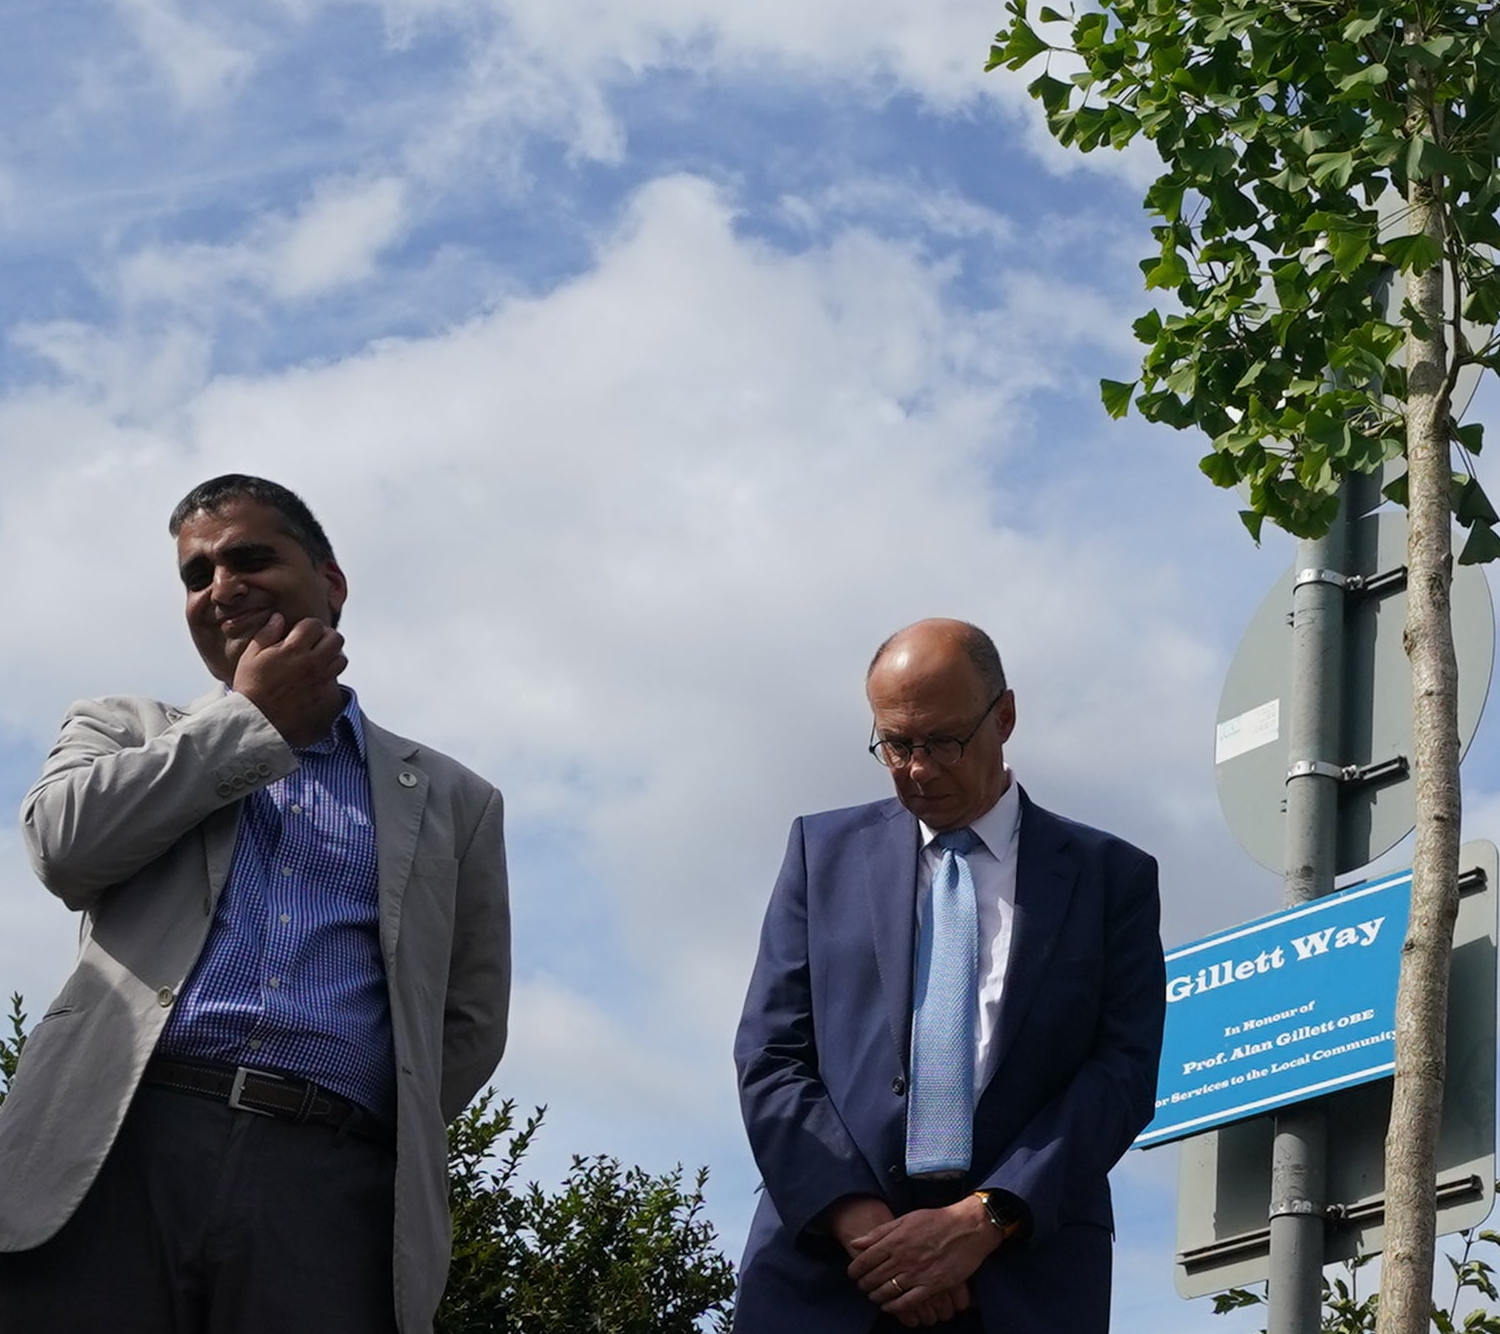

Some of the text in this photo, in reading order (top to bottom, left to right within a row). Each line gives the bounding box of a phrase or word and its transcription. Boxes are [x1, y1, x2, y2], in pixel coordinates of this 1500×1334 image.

[1165, 915, 1387, 1003] Gillett Way
[1182, 1008, 1376, 1075] Prof. Alan Gillett OBE
[1224, 1000, 1317, 1038] In Honour of
[1154, 1097, 1170, 1108] or
[1170, 1079, 1230, 1104] Services
[1230, 1074, 1245, 1086] to
[1246, 1068, 1270, 1081] the
[1270, 1053, 1311, 1074] Local
